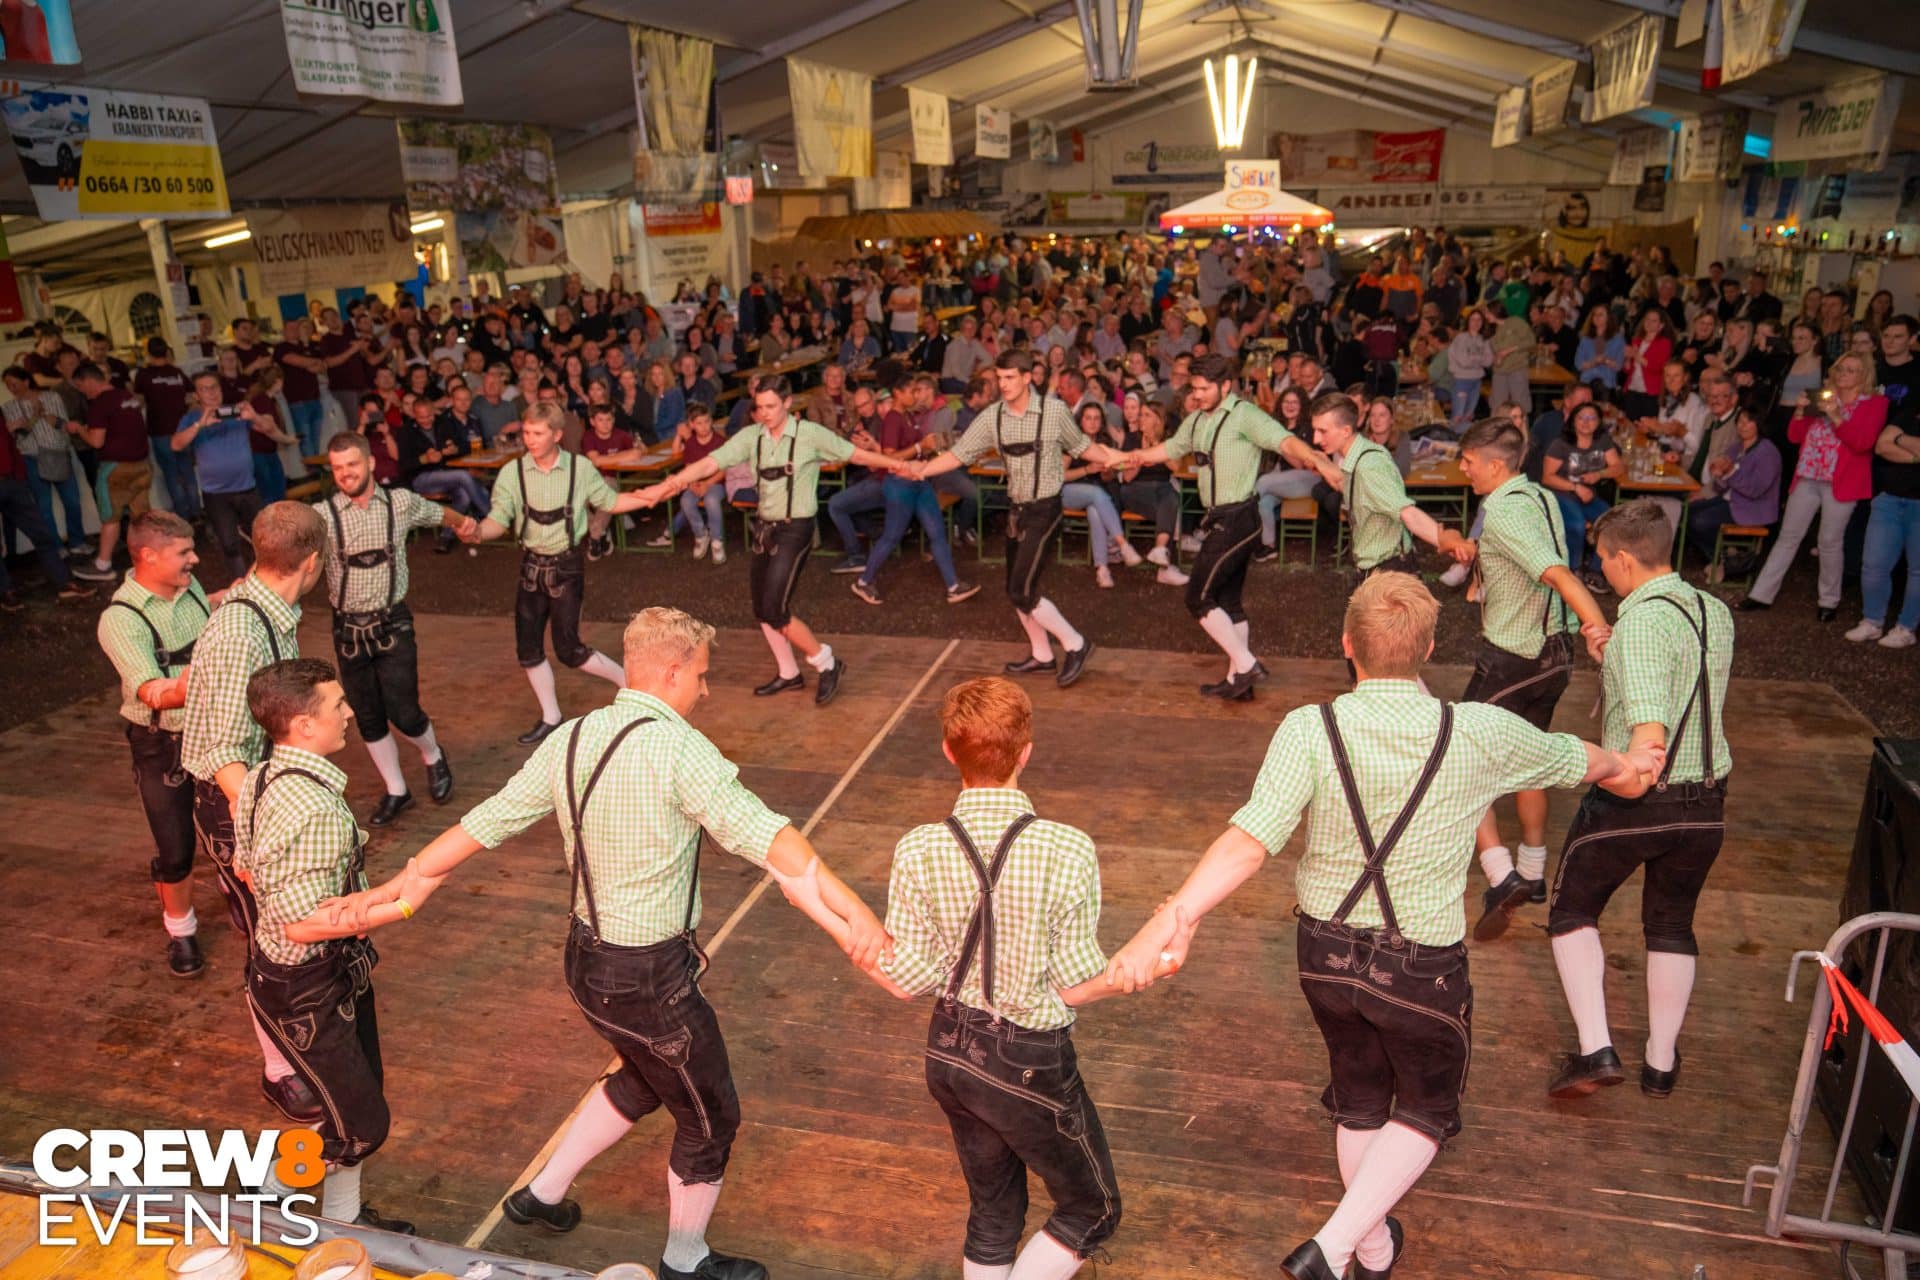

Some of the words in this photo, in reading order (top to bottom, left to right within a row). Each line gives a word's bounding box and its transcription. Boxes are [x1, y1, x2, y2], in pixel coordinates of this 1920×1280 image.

[106, 103, 153, 121] HABBI
[157, 106, 191, 123] TAXI
[85, 175, 129, 193] 0664
[166, 177, 183, 193] 60
[187, 177, 214, 194] 500
